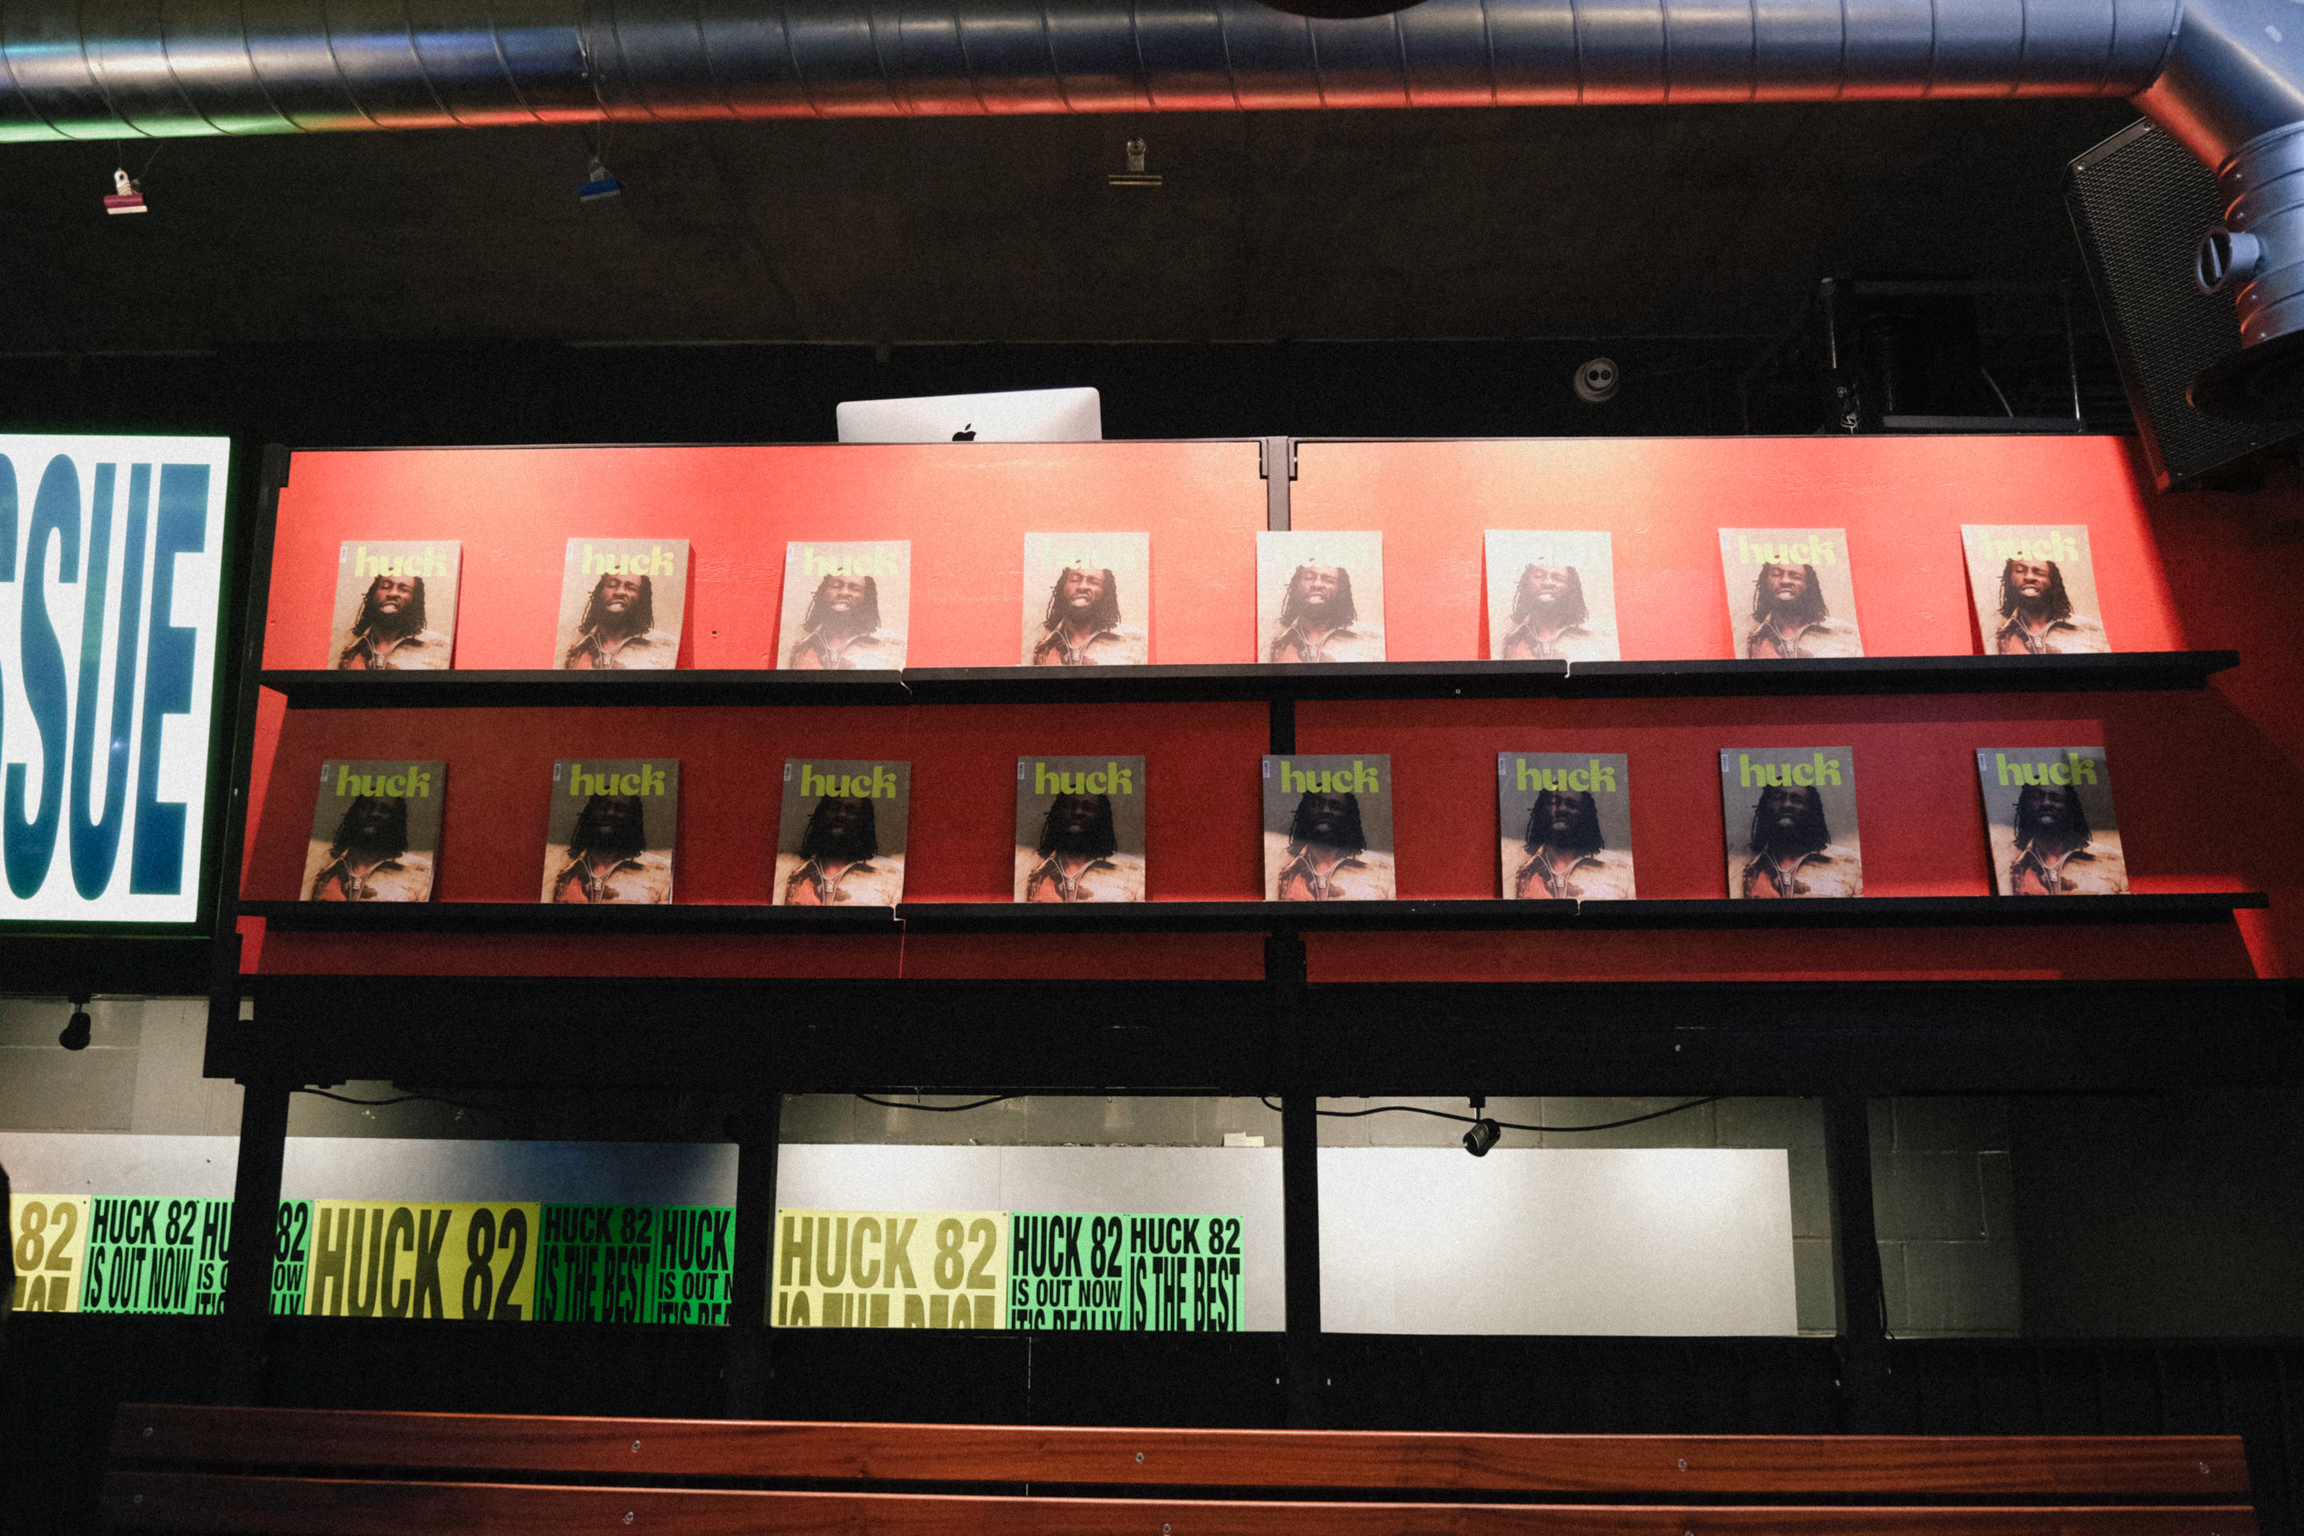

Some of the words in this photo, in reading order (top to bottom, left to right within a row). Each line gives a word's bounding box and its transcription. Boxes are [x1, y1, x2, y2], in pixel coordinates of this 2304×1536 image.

[355, 546, 447, 577] huck
[581, 544, 674, 576] huck
[803, 547, 898, 576] huck
[1738, 534, 1836, 565] huck
[1981, 530, 2079, 562] huck
[336, 765, 431, 797] huck
[569, 764, 665, 796] huck
[800, 764, 897, 798] huck
[1035, 762, 1132, 795] huck
[1280, 760, 1379, 793] huck
[1516, 758, 1616, 792] huck
[1739, 753, 1842, 787] huck
[1996, 752, 2098, 786] huck
[15, 1201, 78, 1271] 82
[91, 1199, 160, 1244] HUCK
[165, 1200, 197, 1245] 82
[200, 1202, 232, 1262] HU
[275, 1202, 308, 1262] 82
[544, 1207, 614, 1243] HUCK
[620, 1207, 653, 1244] 82
[1130, 1217, 1200, 1254] HUCK
[1208, 1218, 1240, 1255] 82
[660, 1209, 731, 1271] HUCK
[780, 1216, 918, 1288] HUCK
[934, 1217, 997, 1290] 82
[1012, 1215, 1083, 1277] HUCK
[1091, 1216, 1123, 1278] 82
[84, 1245, 105, 1308] IS
[108, 1246, 147, 1308] OUT
[147, 1247, 194, 1309] NOW
[197, 1263, 215, 1290] IS
[273, 1264, 304, 1291] OW
[311, 1206, 453, 1319] HUCK
[461, 1207, 527, 1321] 82
[540, 1244, 559, 1321] IS
[564, 1245, 599, 1321] THE
[602, 1245, 650, 1323] BEST
[658, 1271, 676, 1300] IS
[682, 1271, 719, 1300] OUT
[1012, 1279, 1029, 1306] IS
[1036, 1279, 1072, 1307] OUT
[1079, 1280, 1122, 1308] NOW
[1130, 1256, 1147, 1331] IS
[1152, 1256, 1187, 1331] THE
[1194, 1256, 1240, 1331] BEST
